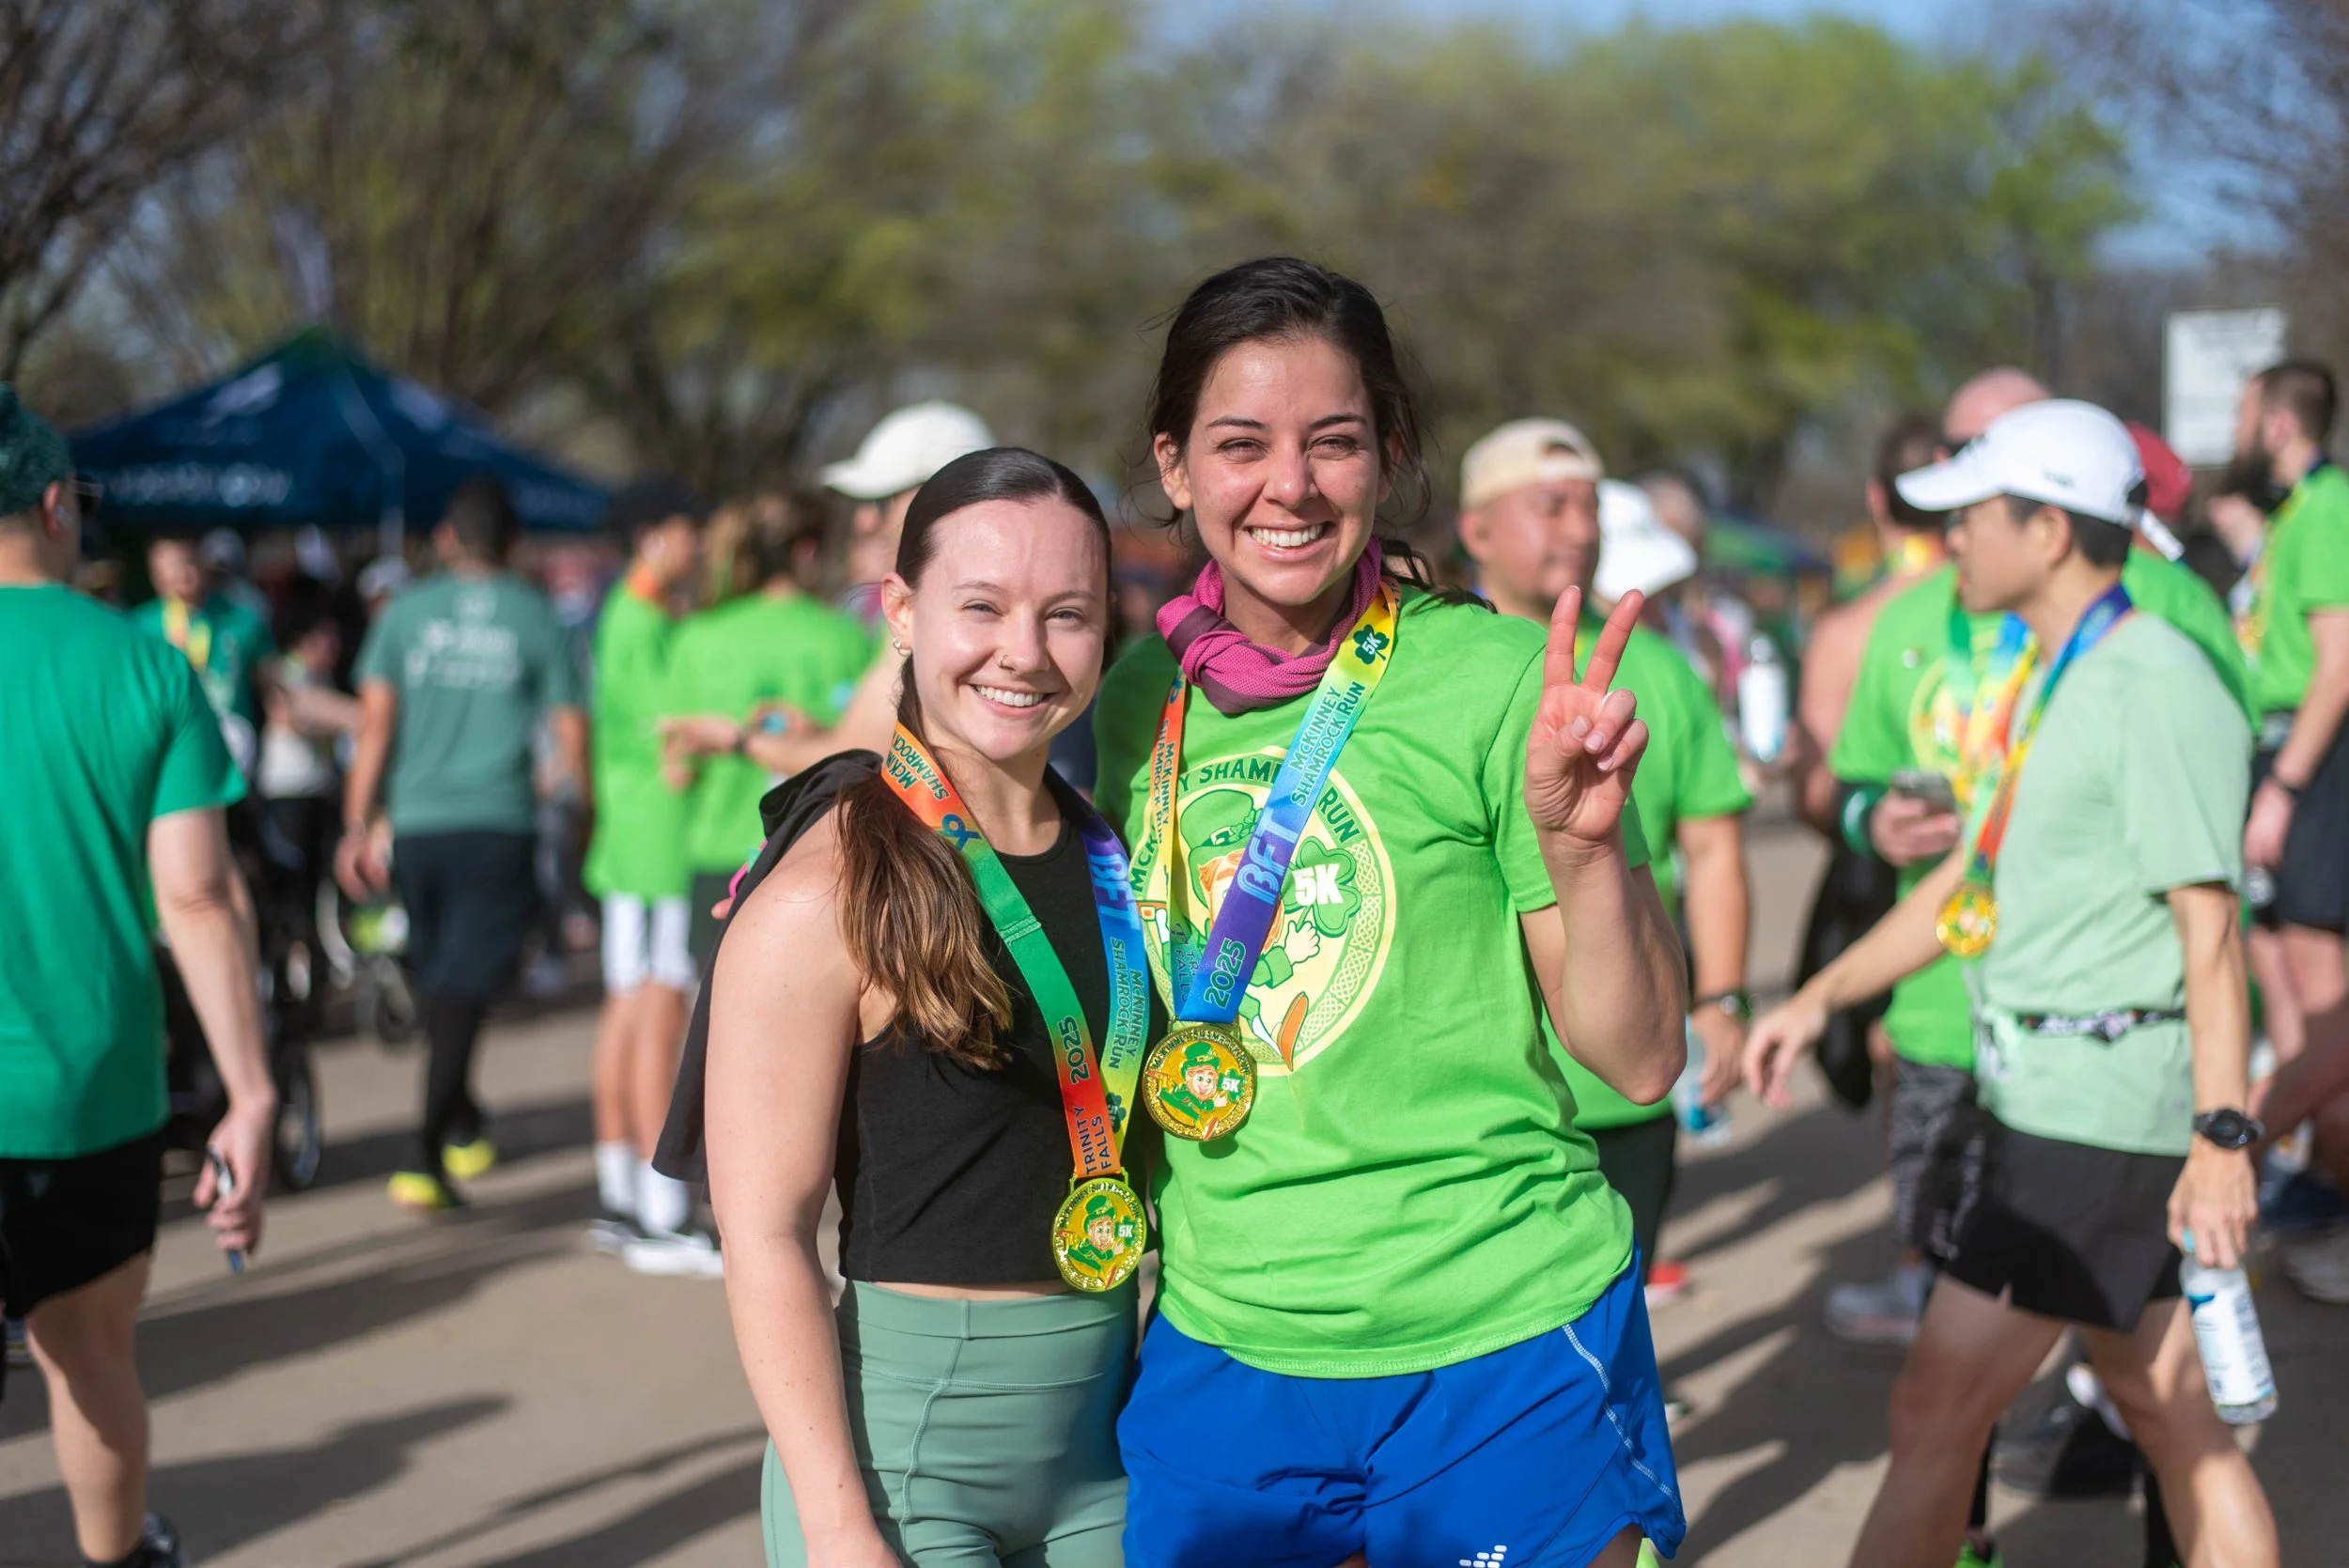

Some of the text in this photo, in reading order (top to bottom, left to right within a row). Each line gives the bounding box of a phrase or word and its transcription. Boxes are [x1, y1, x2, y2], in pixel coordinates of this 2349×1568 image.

[1361, 632, 1381, 655] 5K
[1154, 719, 1169, 805] SHAMROCK
[1288, 685, 1342, 772] MCKINNEY
[1290, 681, 1366, 808] SHAMROCK RUN
[1199, 758, 1283, 784] SHAM
[1318, 786, 1361, 844] RUN
[1237, 807, 1299, 905] BFT
[1291, 863, 1344, 906] 5K
[1109, 937, 1131, 1069] SHAMROCK RUN
[1204, 937, 1246, 1009] 2025
[1126, 969, 1144, 1057] MCKINNEY
[1057, 1015, 1090, 1085] 2025
[1222, 1077, 1241, 1093] 5K
[1073, 1107, 1097, 1175] TRINITY
[1091, 1115, 1112, 1171] FALLS
[1118, 1224, 1133, 1238] 5K
